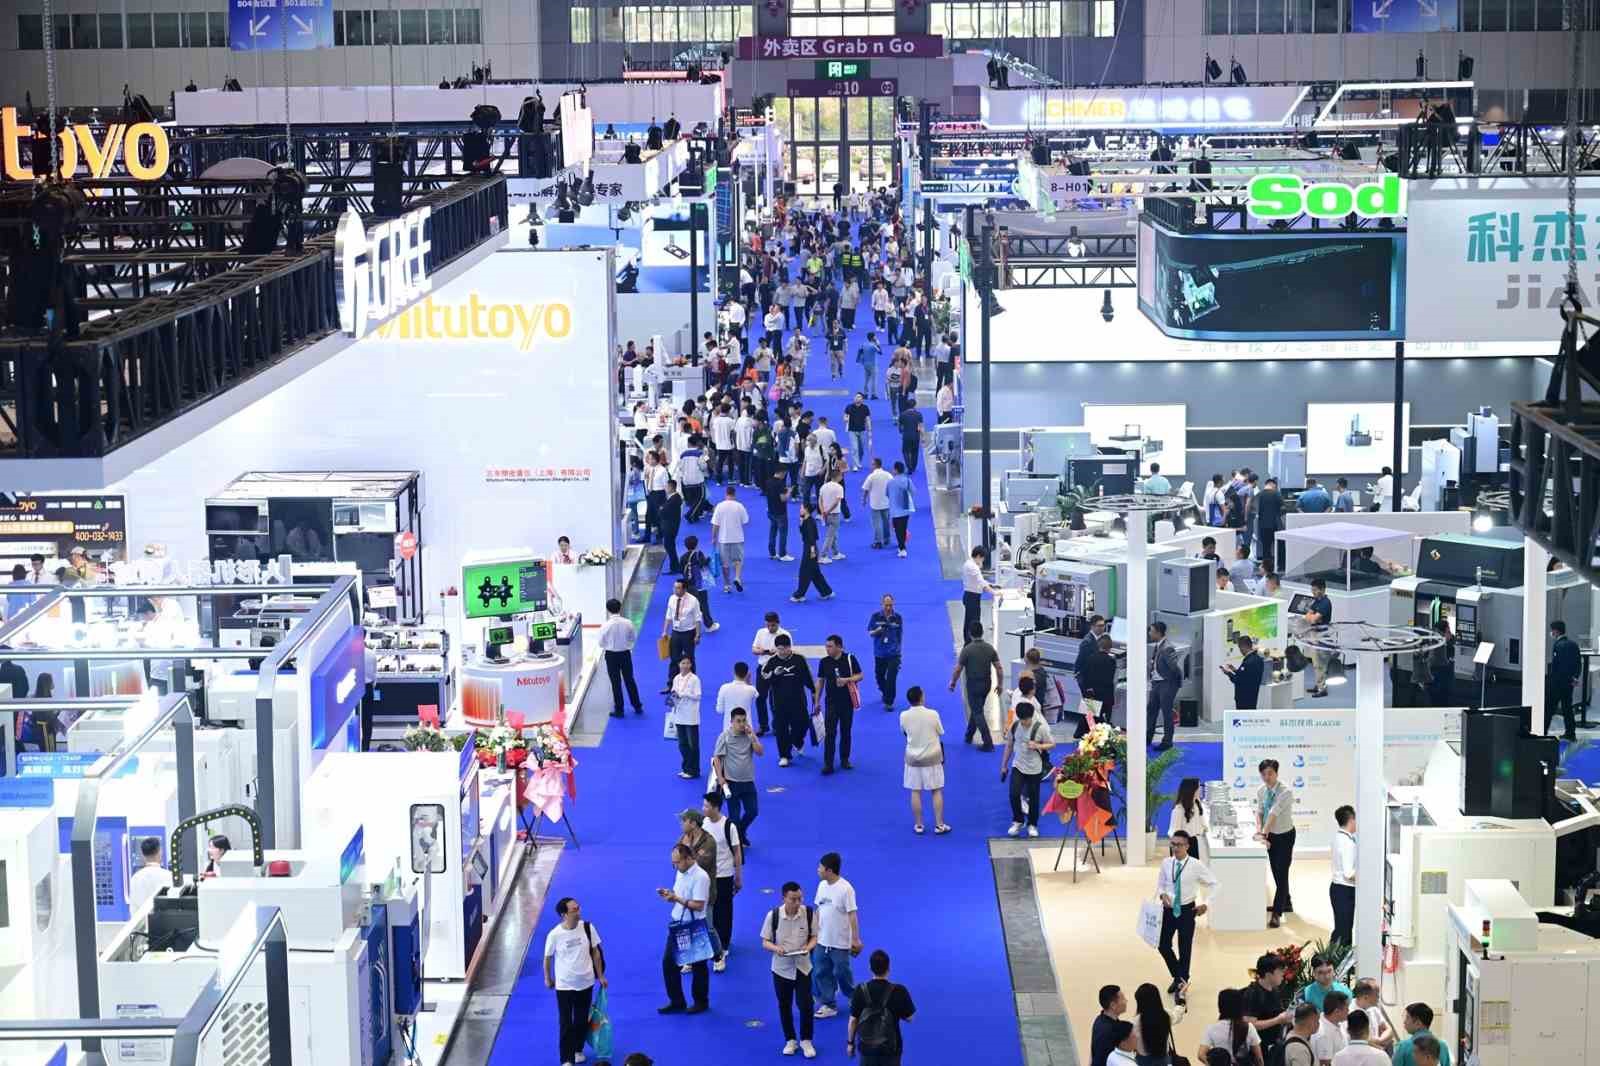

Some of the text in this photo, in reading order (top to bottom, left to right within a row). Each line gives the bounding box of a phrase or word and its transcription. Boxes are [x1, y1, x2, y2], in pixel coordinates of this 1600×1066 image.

[763, 38, 915, 56] 外卖区 Grab n Go
[843, 81, 859, 95] 10
[1248, 173, 1403, 218] Sod
[1467, 211, 1600, 262] 科杰
